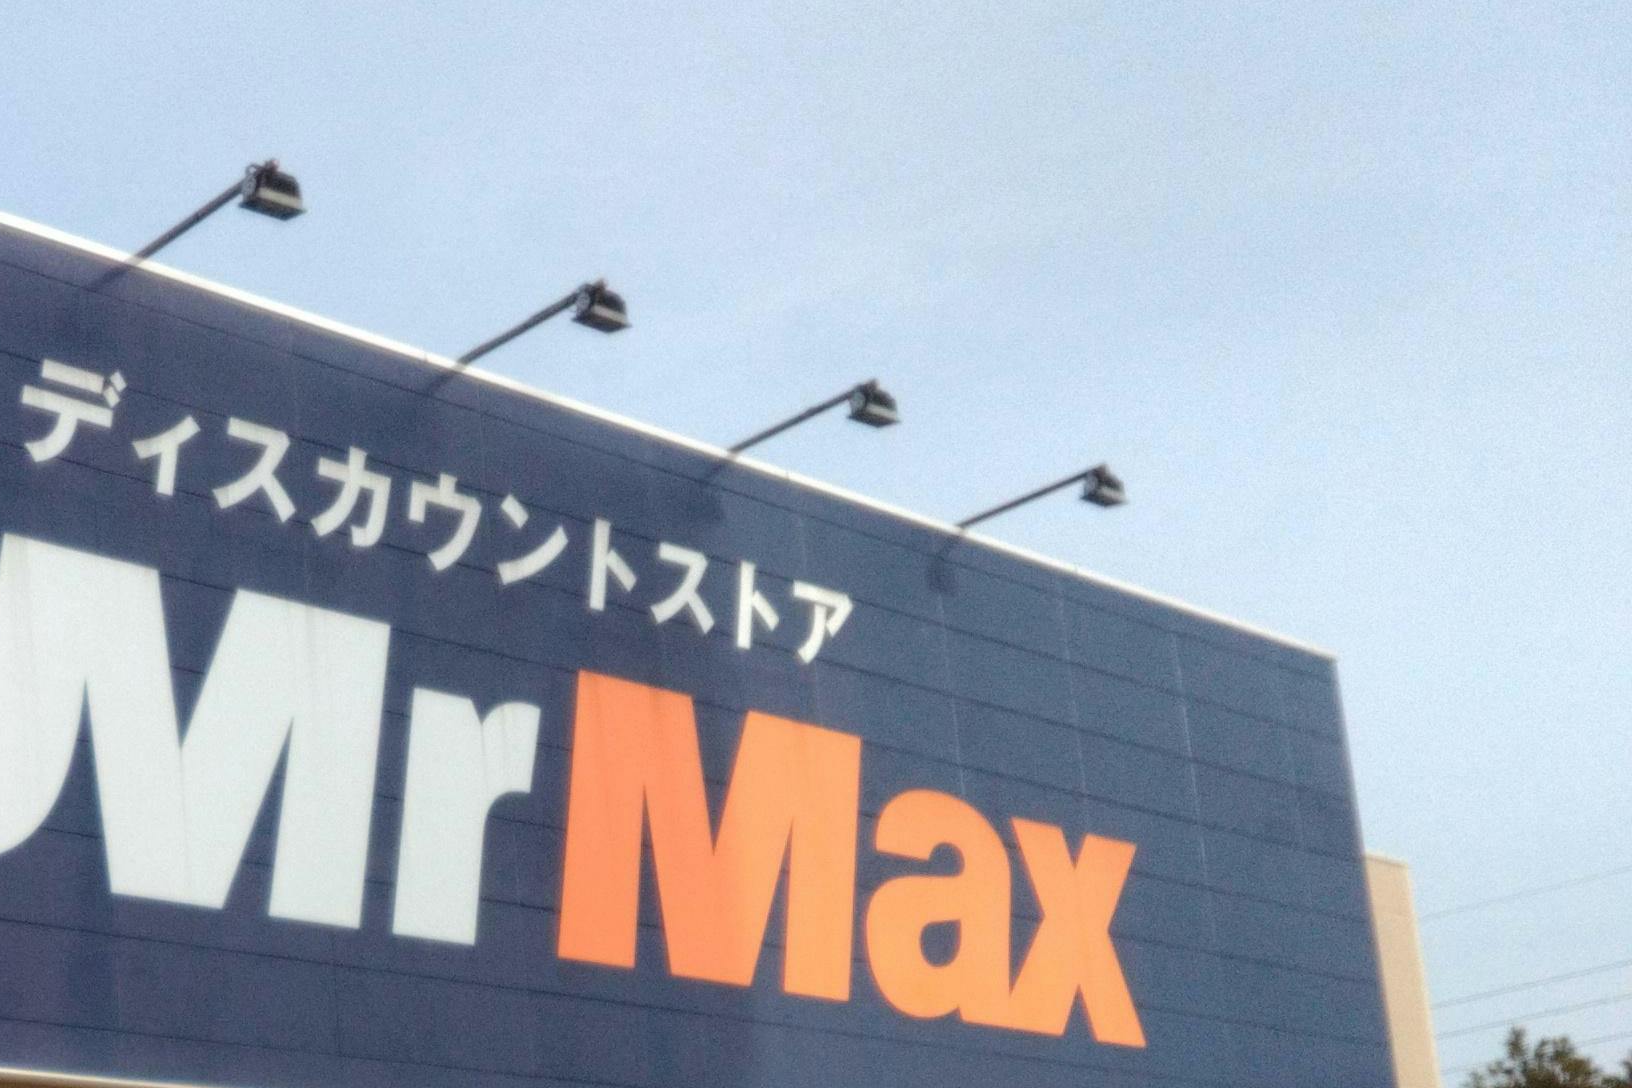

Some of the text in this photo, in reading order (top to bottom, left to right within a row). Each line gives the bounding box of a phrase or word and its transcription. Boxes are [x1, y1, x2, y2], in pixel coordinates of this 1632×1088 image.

[20, 359, 853, 664] ディスカウントストア
